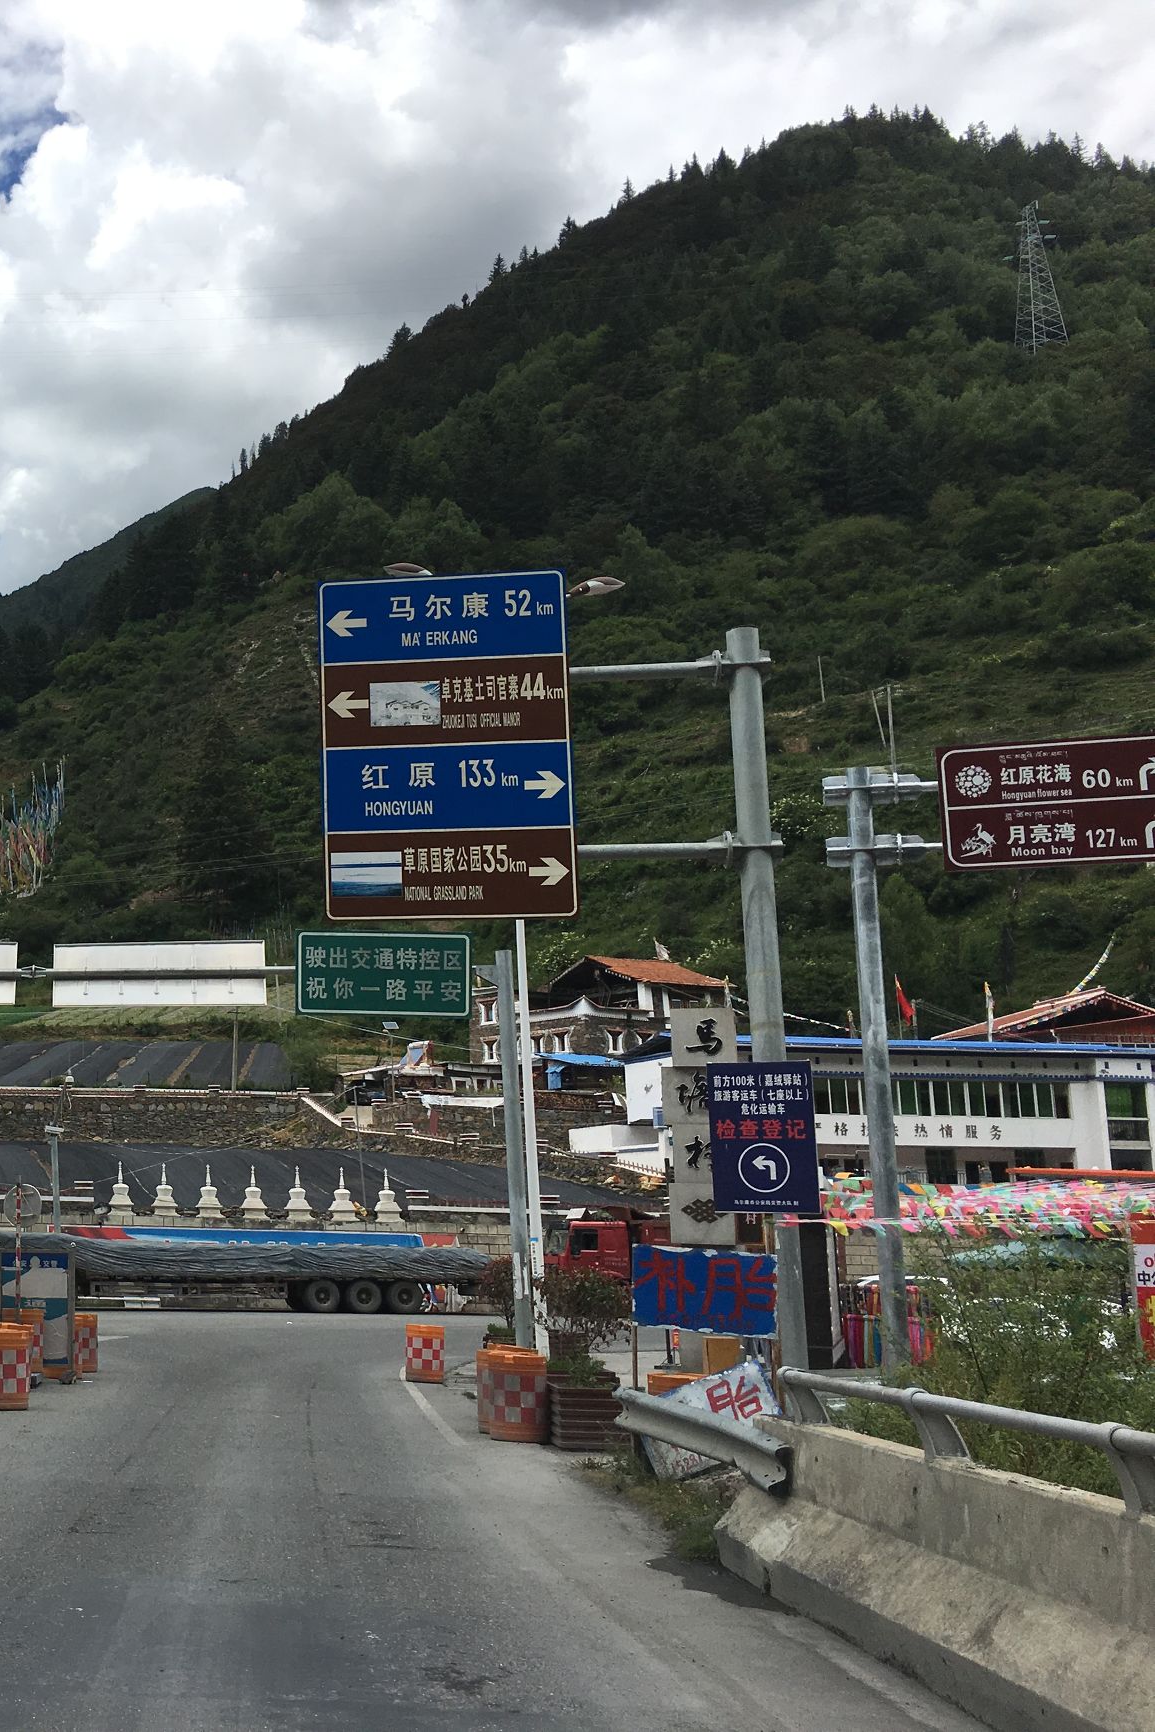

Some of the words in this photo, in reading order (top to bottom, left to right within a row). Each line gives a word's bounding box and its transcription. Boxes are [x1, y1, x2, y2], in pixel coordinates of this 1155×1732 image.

[389, 592, 489, 621] 马尔康
[504, 589, 532, 617] 52
[536, 602, 554, 616] km
[426, 629, 478, 646] ERKANG
[441, 674, 519, 703] 卓克基土司官寨
[479, 713, 502, 727] OFFICIAL
[502, 712, 521, 727] MANOR
[361, 762, 436, 790] 红原
[458, 759, 496, 787] 133
[501, 772, 519, 787] km
[1000, 763, 1072, 786] 红原花海
[1082, 768, 1111, 789] 60
[1115, 776, 1134, 787] km
[1001, 790, 1037, 801] Hongyuan
[1037, 788, 1059, 798] flower
[1060, 788, 1073, 797] sea
[365, 800, 433, 817] HONGYUAN
[1007, 822, 1077, 845] 月亮湾
[1085, 828, 1116, 849] 127
[1120, 836, 1138, 847] km
[404, 846, 482, 874] 草原国家公园
[1011, 846, 1046, 857] Moon
[1051, 845, 1074, 856] bay
[404, 886, 432, 901] NATIONAL
[433, 885, 467, 901] GRASSLAND
[468, 885, 484, 901] PARK
[305, 946, 463, 971] 驶出交通特控区
[306, 976, 462, 1001] 祝你一路平安
[741, 1102, 786, 1115] 危化运输车
[716, 1119, 807, 1140] 检查登记
[634, 1251, 778, 1321] 补胎
[706, 1375, 763, 1421] 胎
